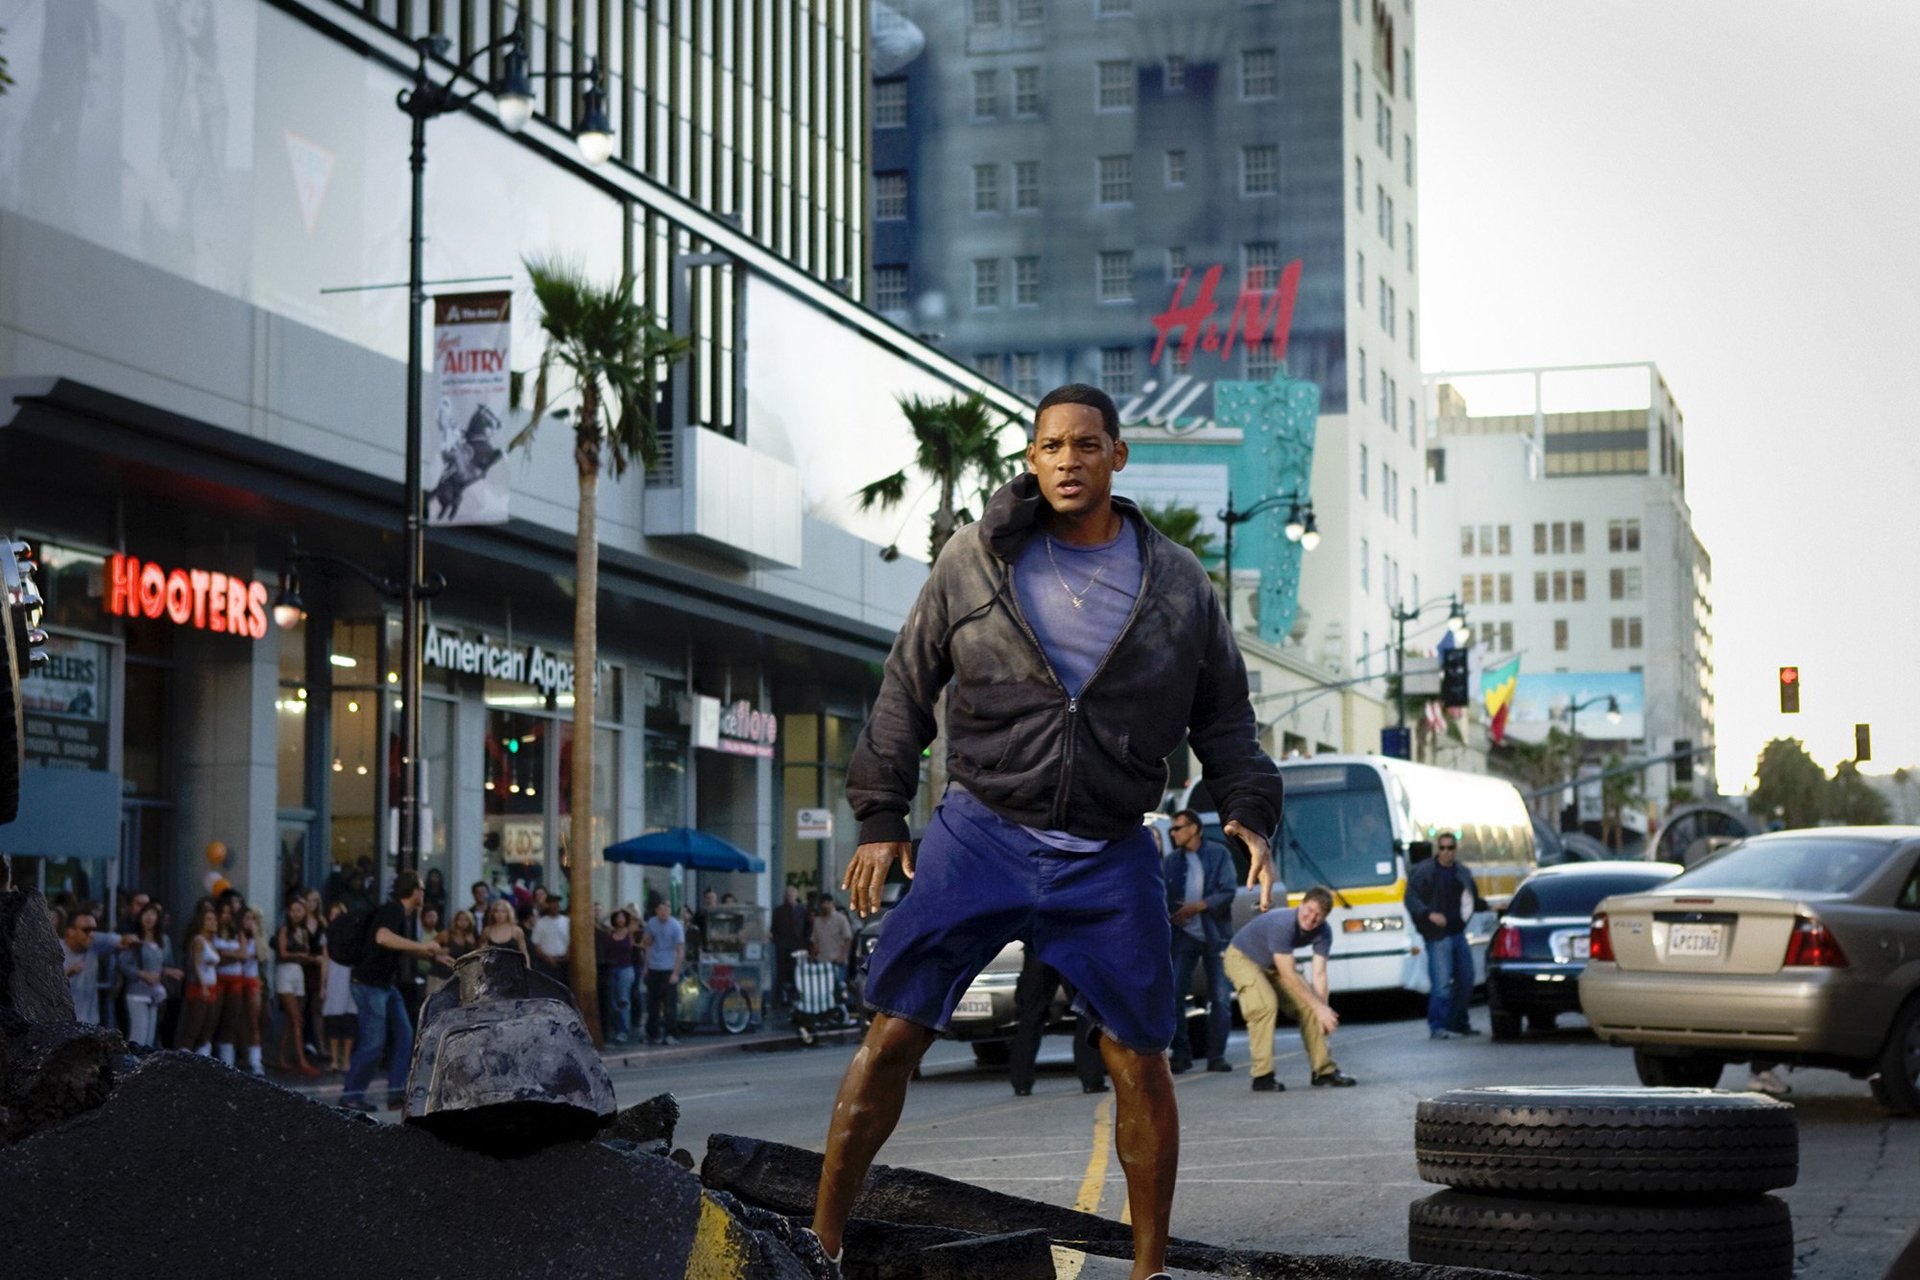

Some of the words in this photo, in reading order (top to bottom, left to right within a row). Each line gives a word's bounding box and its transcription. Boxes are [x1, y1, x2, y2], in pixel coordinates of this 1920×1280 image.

[1151, 258, 1303, 367] H&M
[442, 348, 508, 376] AUTRY
[1118, 375, 1210, 435] ill
[110, 551, 268, 640] HOOTERS
[424, 624, 526, 683] American
